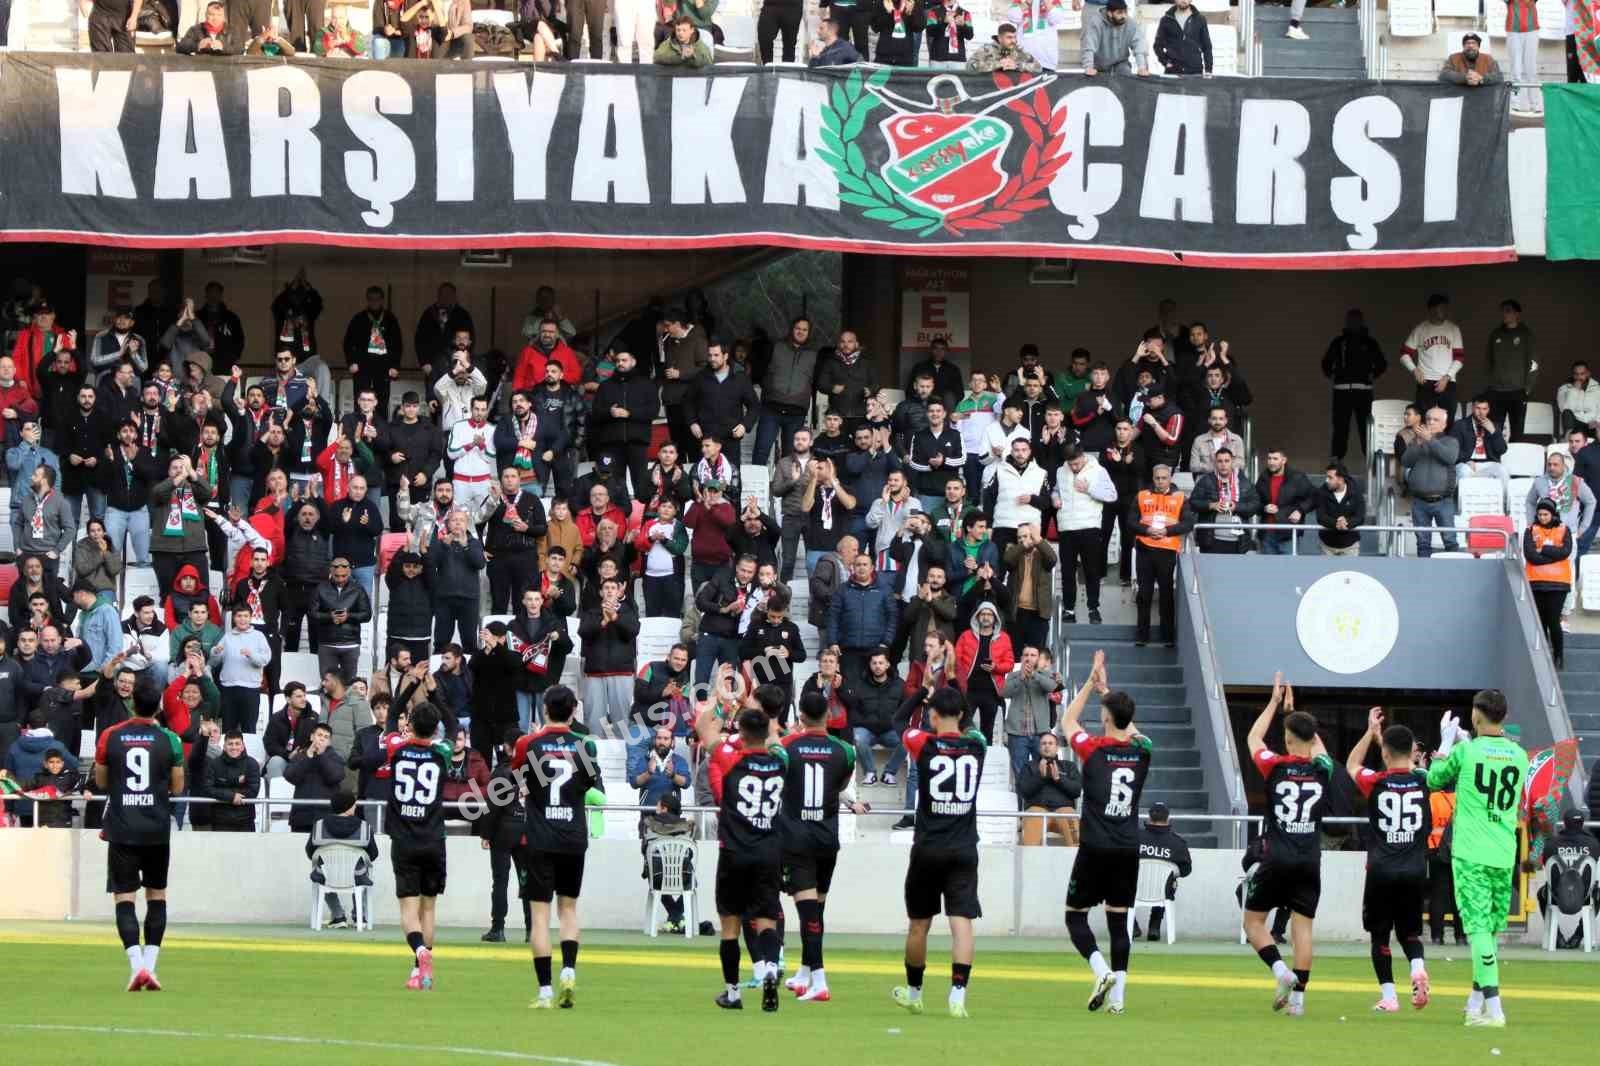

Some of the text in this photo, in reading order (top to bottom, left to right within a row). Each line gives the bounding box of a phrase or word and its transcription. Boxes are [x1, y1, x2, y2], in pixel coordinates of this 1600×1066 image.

[55, 65, 1464, 250] KARŞIYAKA ÇARŞI
[921, 296, 947, 328] E
[126, 747, 150, 792] 9
[394, 760, 440, 805] 59
[548, 759, 573, 806] 7
[803, 762, 825, 807] 11
[929, 754, 979, 802] 20
[1109, 767, 1136, 807] 6
[1474, 763, 1520, 811] 48
[122, 794, 155, 806] HAMZA
[736, 775, 785, 819] 93
[1274, 780, 1323, 822] 37
[1377, 790, 1424, 833] 95
